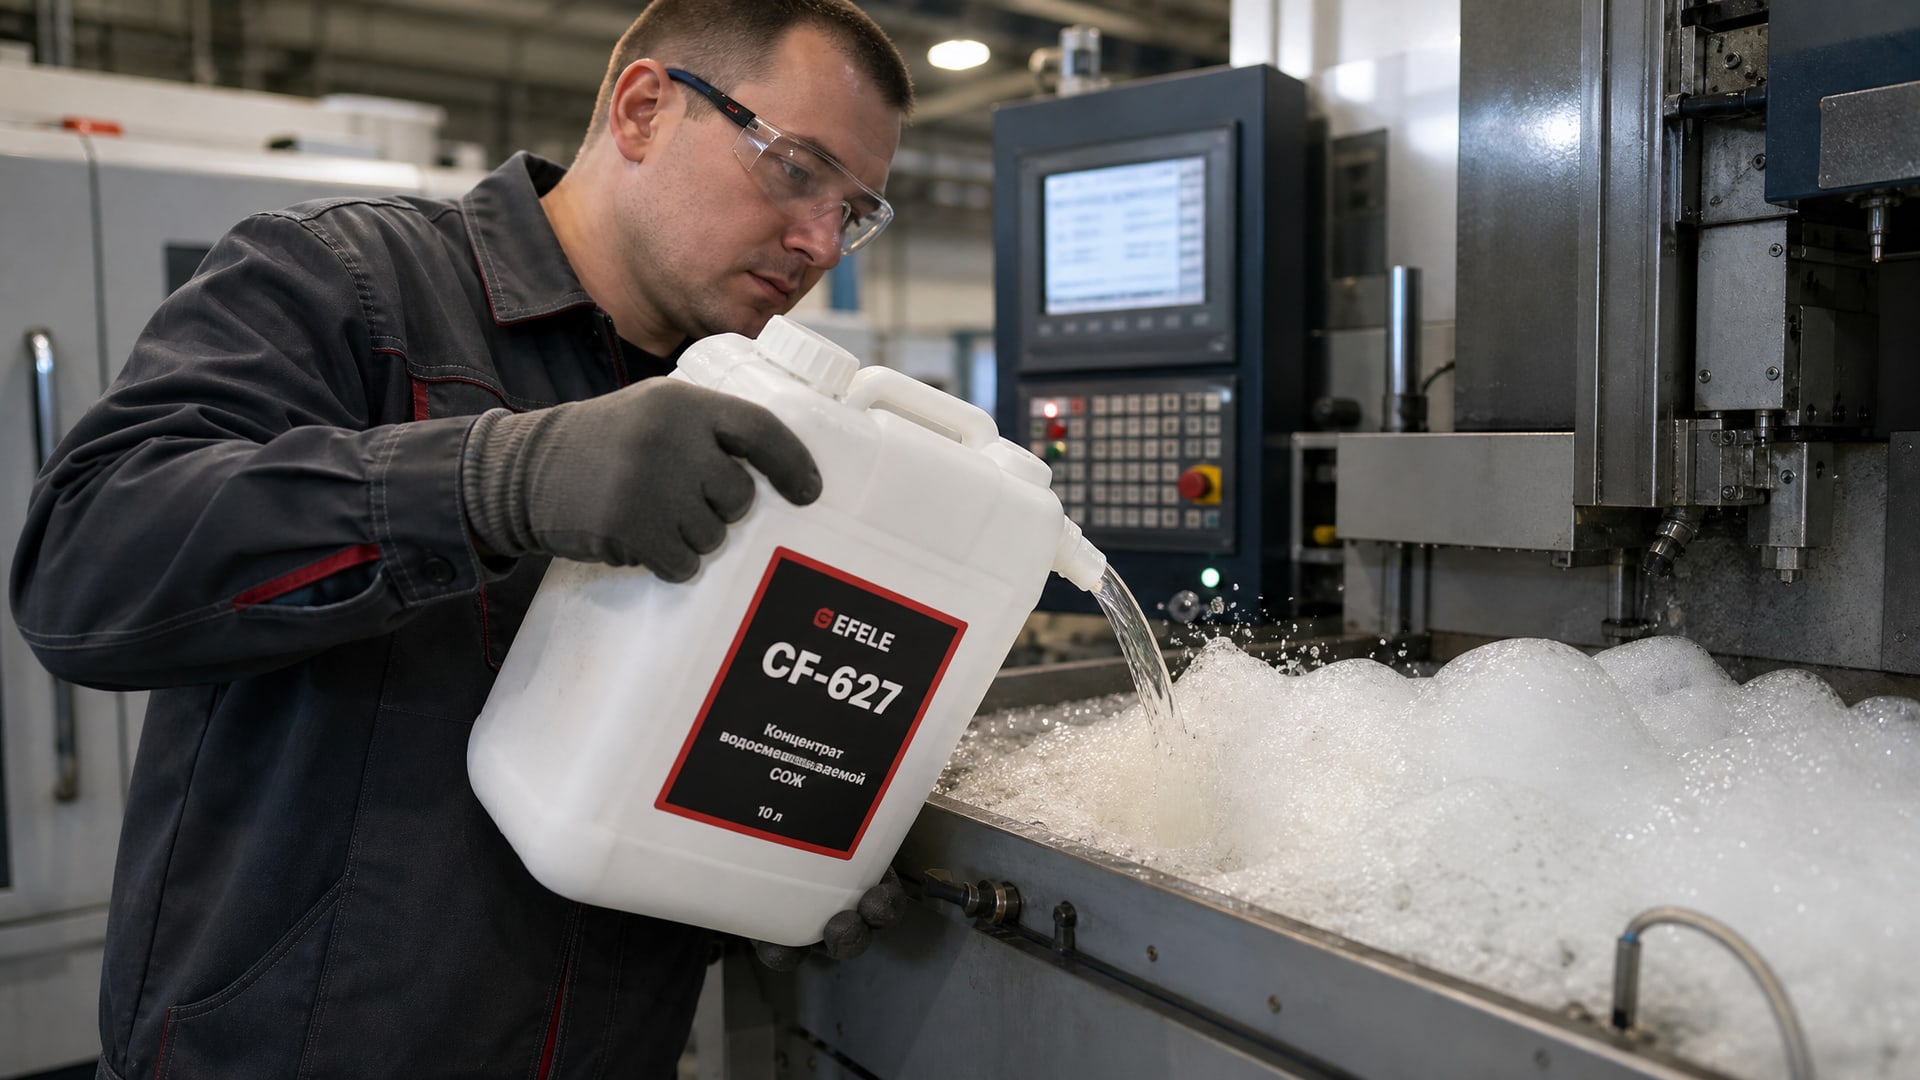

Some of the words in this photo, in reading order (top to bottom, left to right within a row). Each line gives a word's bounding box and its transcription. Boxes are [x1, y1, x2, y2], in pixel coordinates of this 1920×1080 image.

[831, 614, 896, 653] EFELE
[761, 641, 904, 716] CF-627
[763, 722, 845, 760] Концентрат
[769, 767, 807, 788] СОЖ
[757, 805, 774, 819] 10
[772, 812, 784, 822] л
